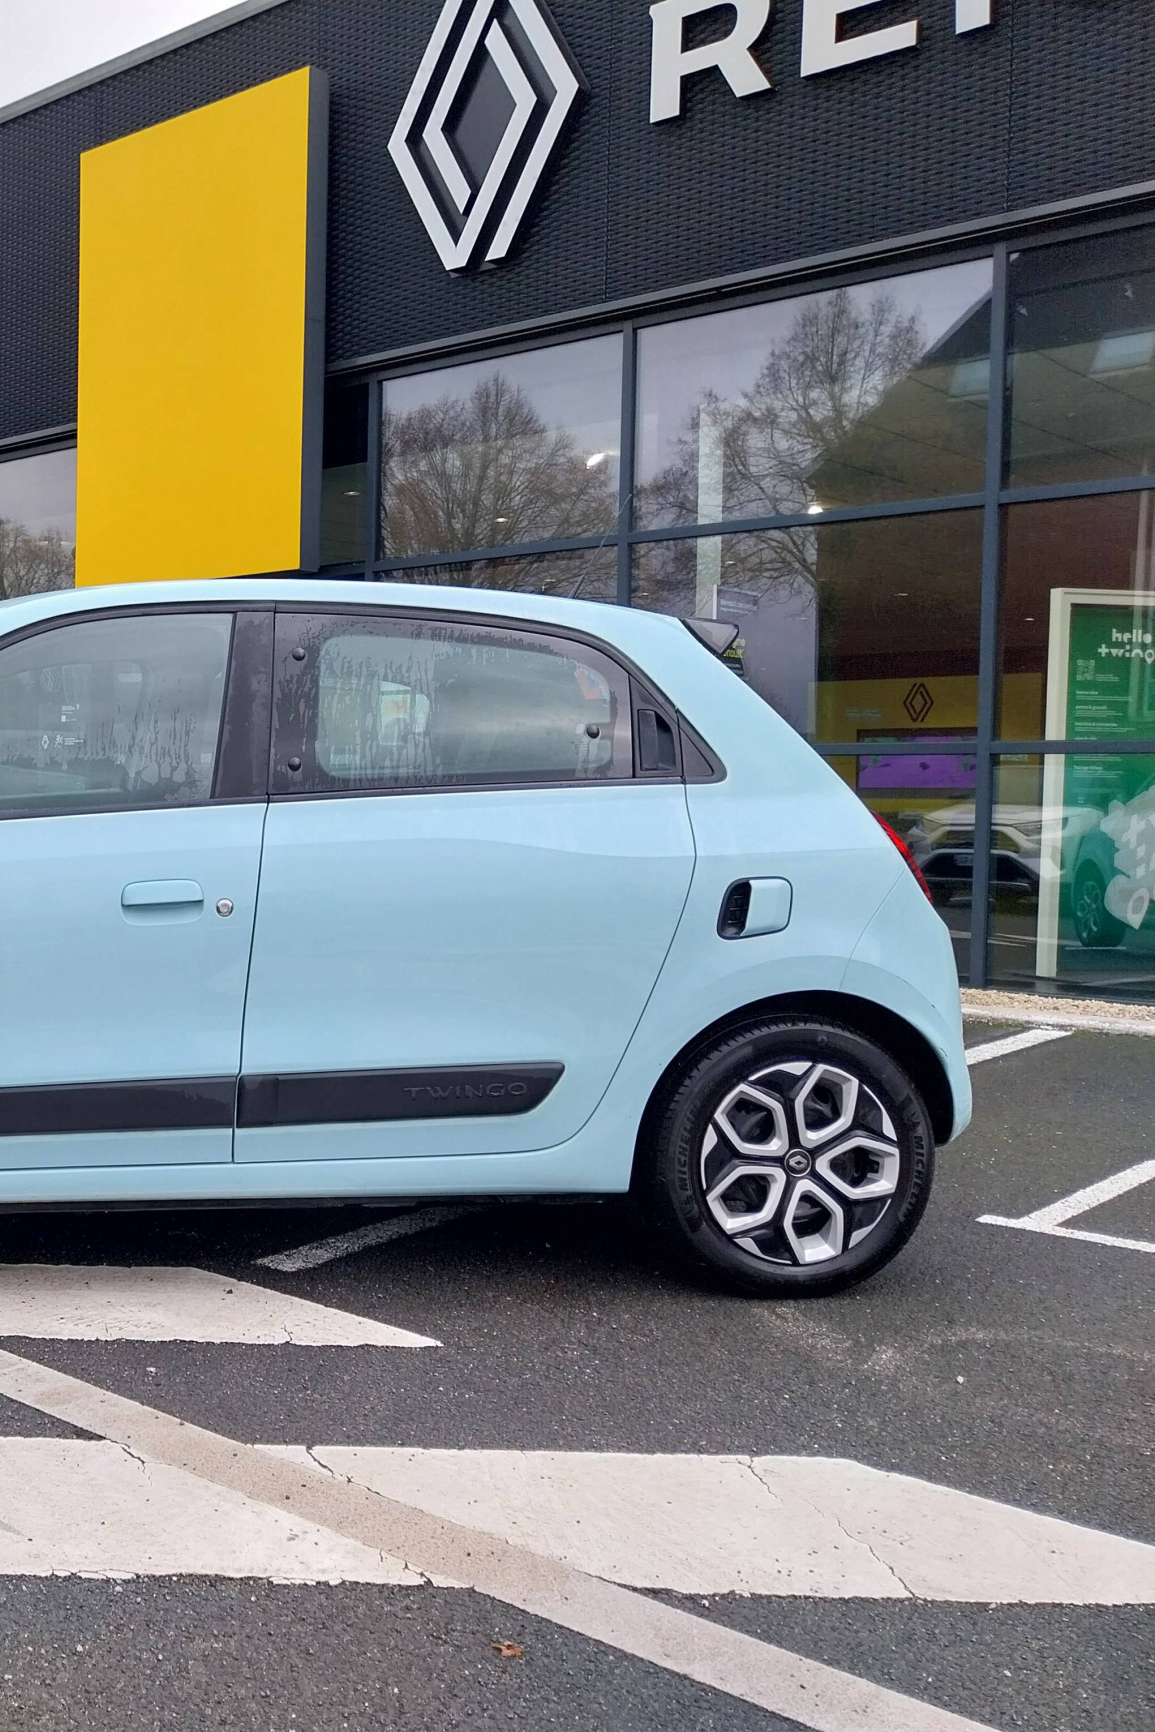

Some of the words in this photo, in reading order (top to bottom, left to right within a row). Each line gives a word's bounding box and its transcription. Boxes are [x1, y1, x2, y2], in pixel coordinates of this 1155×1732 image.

[649, 0, 992, 124] RE
[1111, 628, 1152, 644] hello
[403, 1082, 527, 1100] TWINGO
